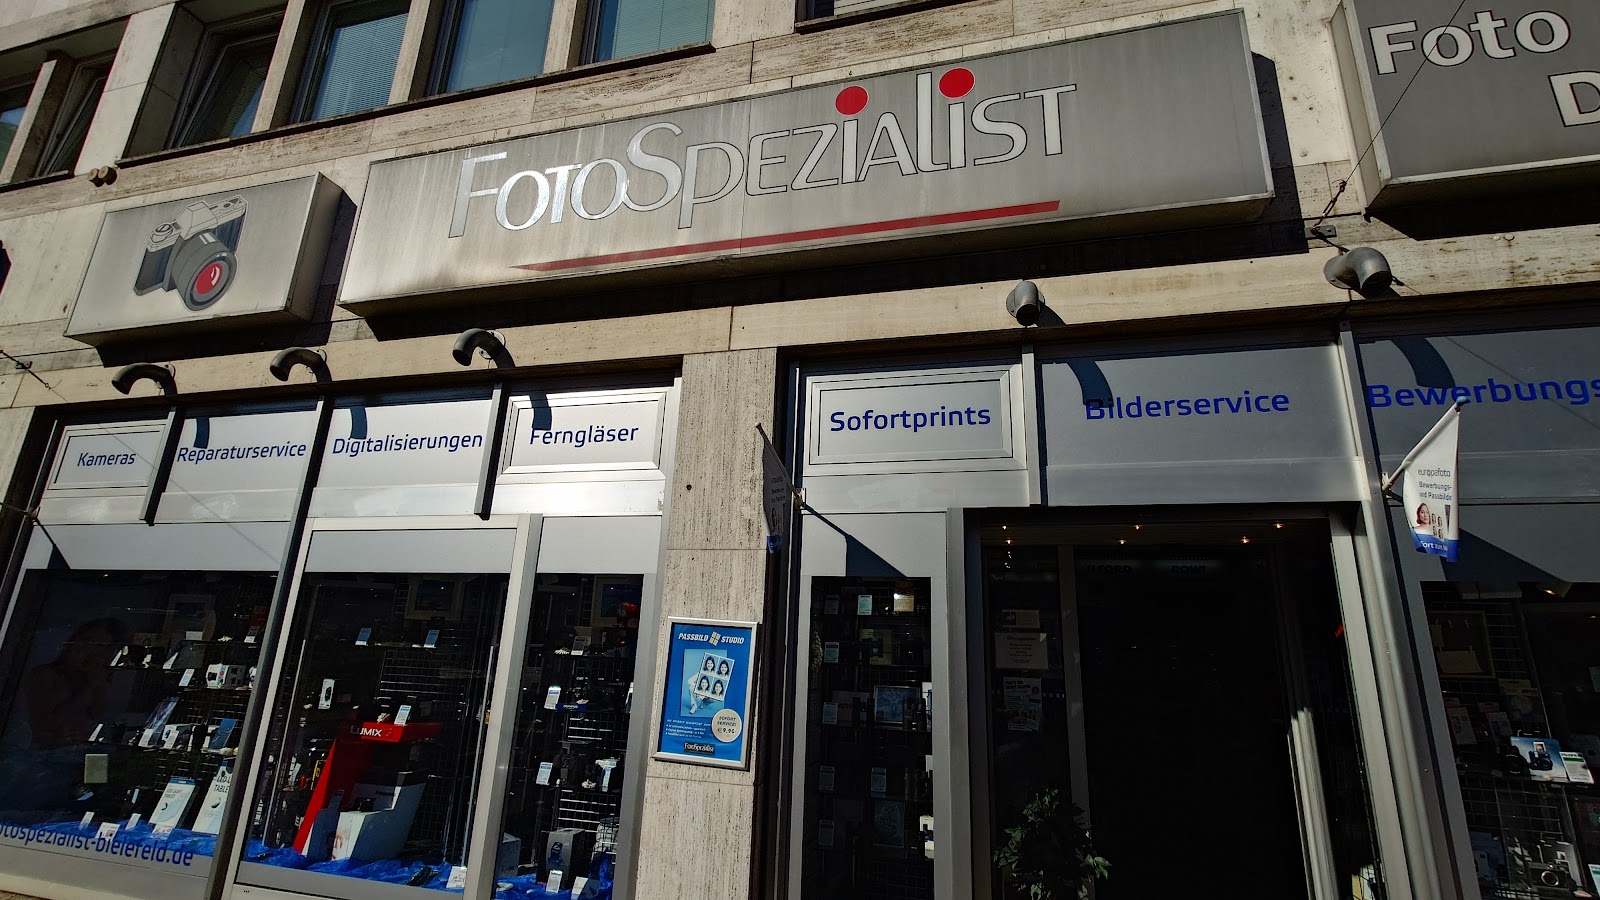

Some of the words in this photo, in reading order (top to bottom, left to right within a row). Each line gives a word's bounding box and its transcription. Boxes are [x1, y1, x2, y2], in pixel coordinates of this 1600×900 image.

[1368, 10, 1571, 75] Foto
[1085, 390, 1290, 420] Bilderservice
[830, 405, 991, 433] Sofortprints
[332, 431, 483, 457] Digitalisierungen
[529, 425, 639, 448] Ferngläser
[77, 451, 136, 467] Kameras
[176, 441, 307, 463] Reparaturservice
[678, 632, 709, 642] PASSBILD
[721, 635, 745, 645] STUDIO
[351, 726, 382, 738] LUMIX
